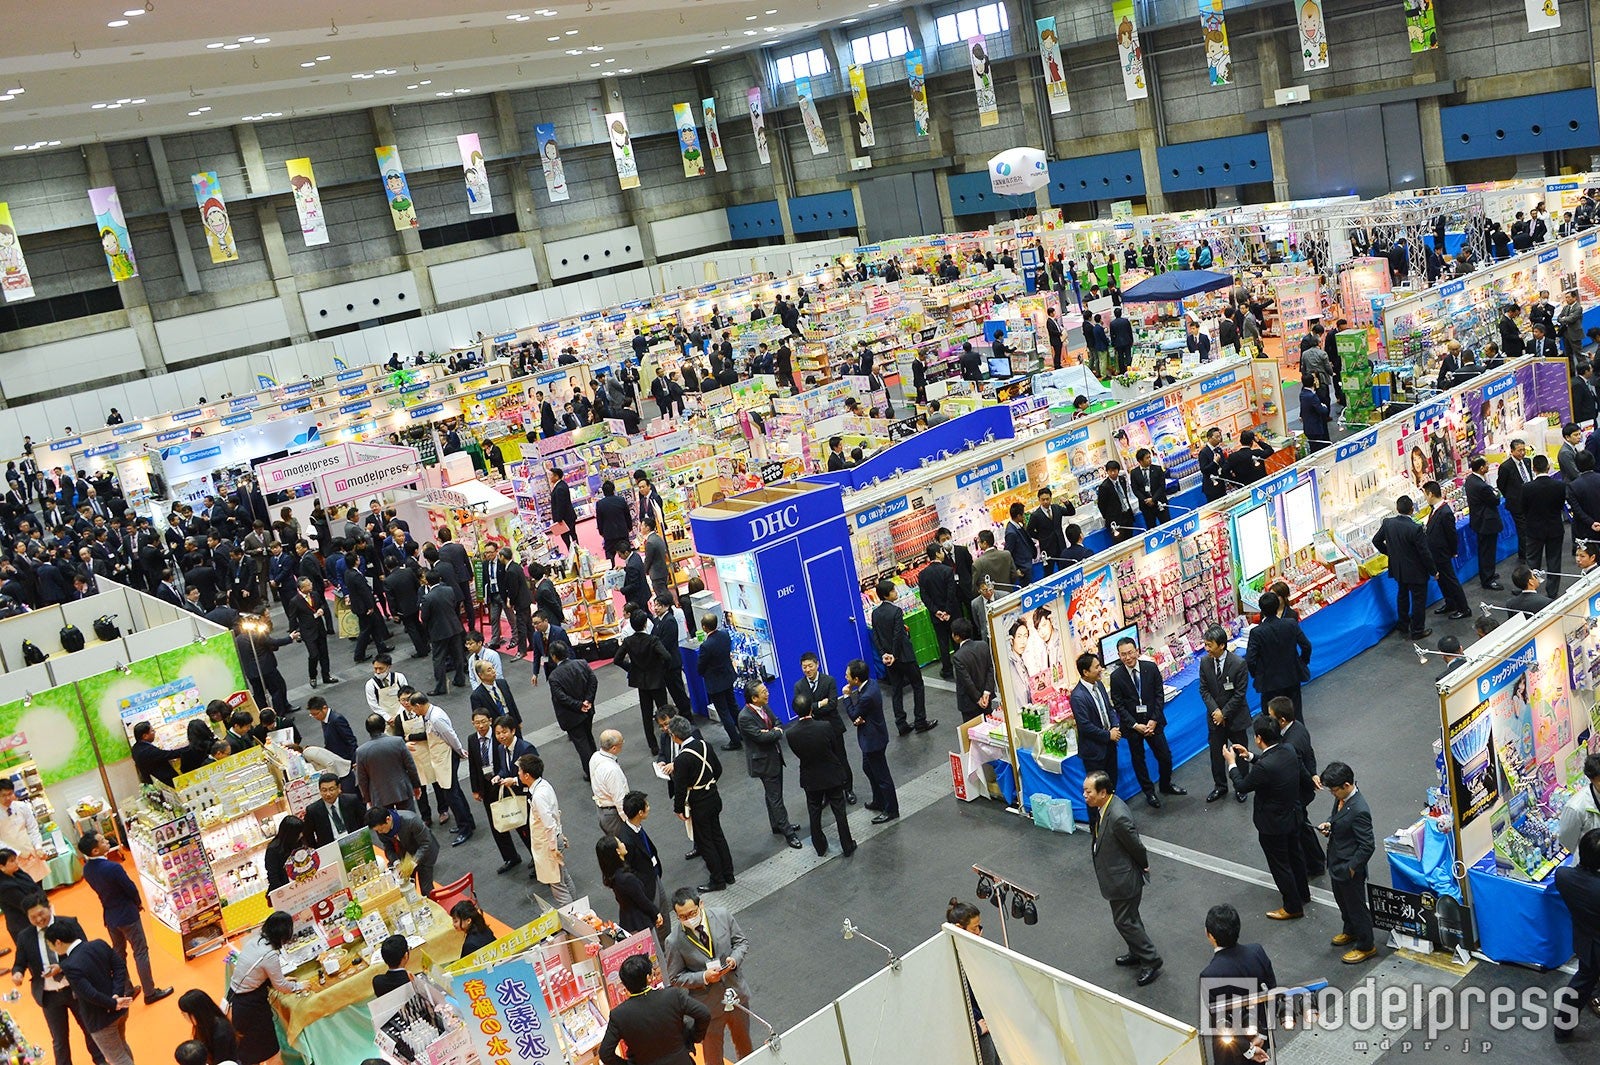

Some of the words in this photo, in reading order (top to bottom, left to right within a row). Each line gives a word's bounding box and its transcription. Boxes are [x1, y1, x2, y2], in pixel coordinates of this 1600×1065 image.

[283, 456, 340, 478] modelpress
[347, 463, 409, 488] modelpress
[749, 504, 800, 542] DHC
[777, 584, 795, 599] DHC
[219, 752, 258, 772] RELEASE
[1374, 898, 1427, 924] 直に効く
[472, 948, 498, 967] NEW
[500, 919, 554, 955] RELEASE
